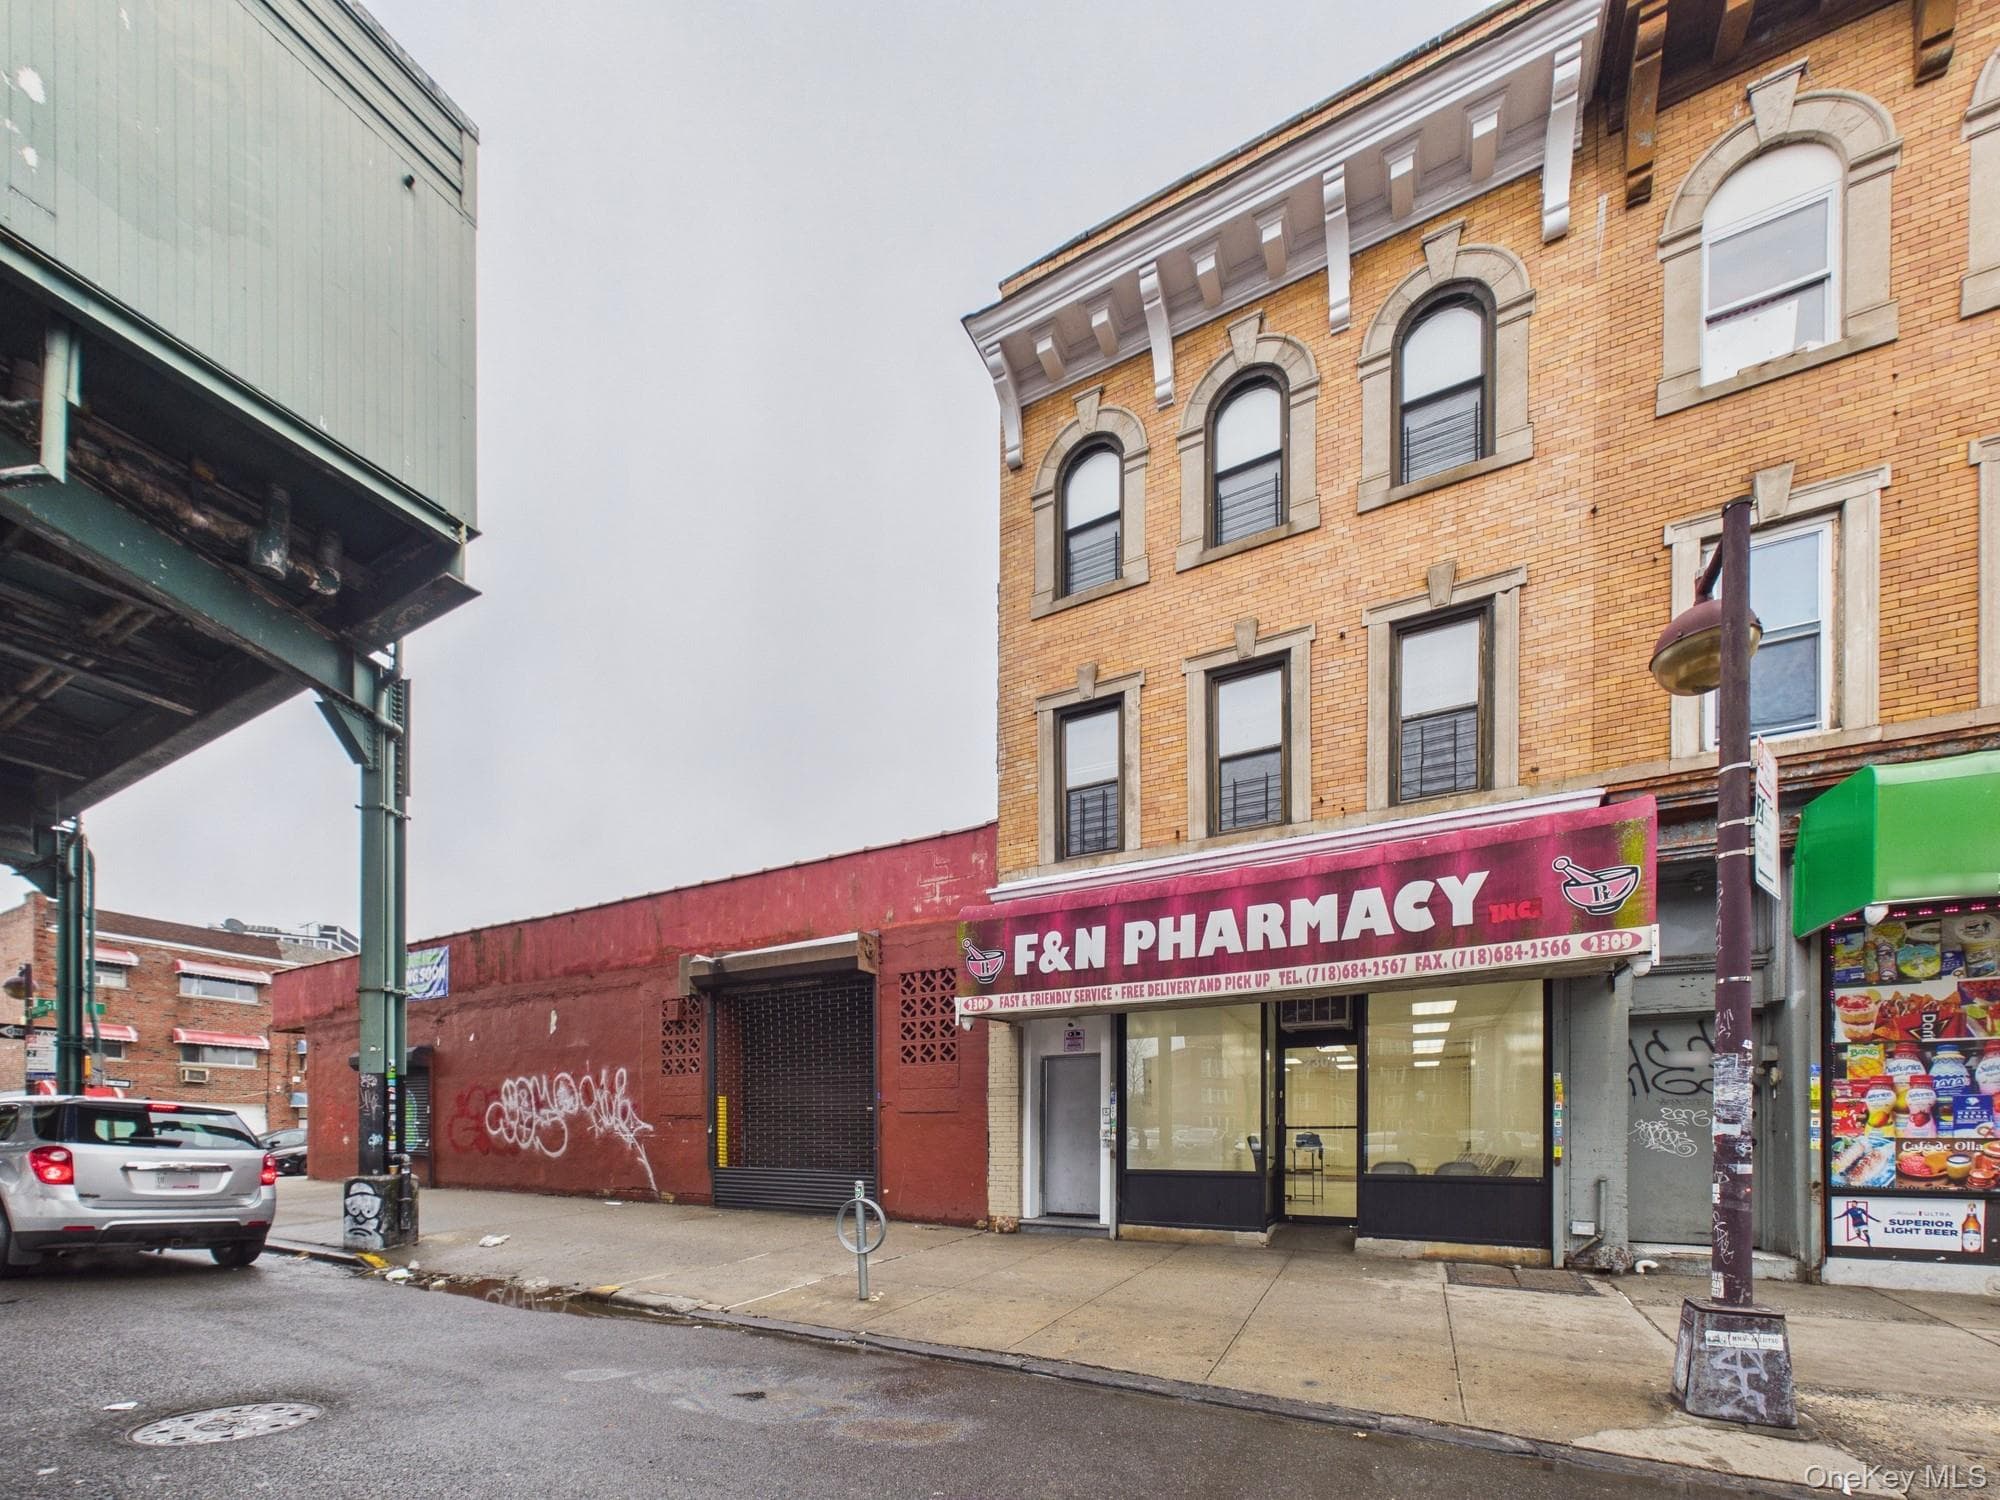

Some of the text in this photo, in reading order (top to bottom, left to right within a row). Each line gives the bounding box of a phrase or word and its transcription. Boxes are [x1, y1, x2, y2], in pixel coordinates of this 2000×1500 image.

[1014, 925, 1107, 976] F&N
[1123, 871, 1490, 966] PHARMACY
[1589, 932, 1633, 950] 2309
[999, 995, 1020, 1009] FAST
[1021, 994, 1028, 1007] &
[1030, 990, 1072, 1006] FRIENDLY
[1074, 987, 1113, 1003] SERVICE
[1121, 984, 1145, 1000] FREE
[1147, 979, 1197, 996] DELIVERY
[1198, 978, 1222, 993] AND
[1224, 975, 1251, 991] PICK
[1255, 972, 1271, 988] UP
[1278, 970, 1303, 986] TEL.
[1415, 952, 1448, 972] FAX.
[967, 998, 989, 1012] 2309
[1954, 1140, 1983, 1151] Olla
[1888, 1218, 1954, 1228] SUPERIOR
[1884, 1227, 1958, 1237] LIGHT BEER
